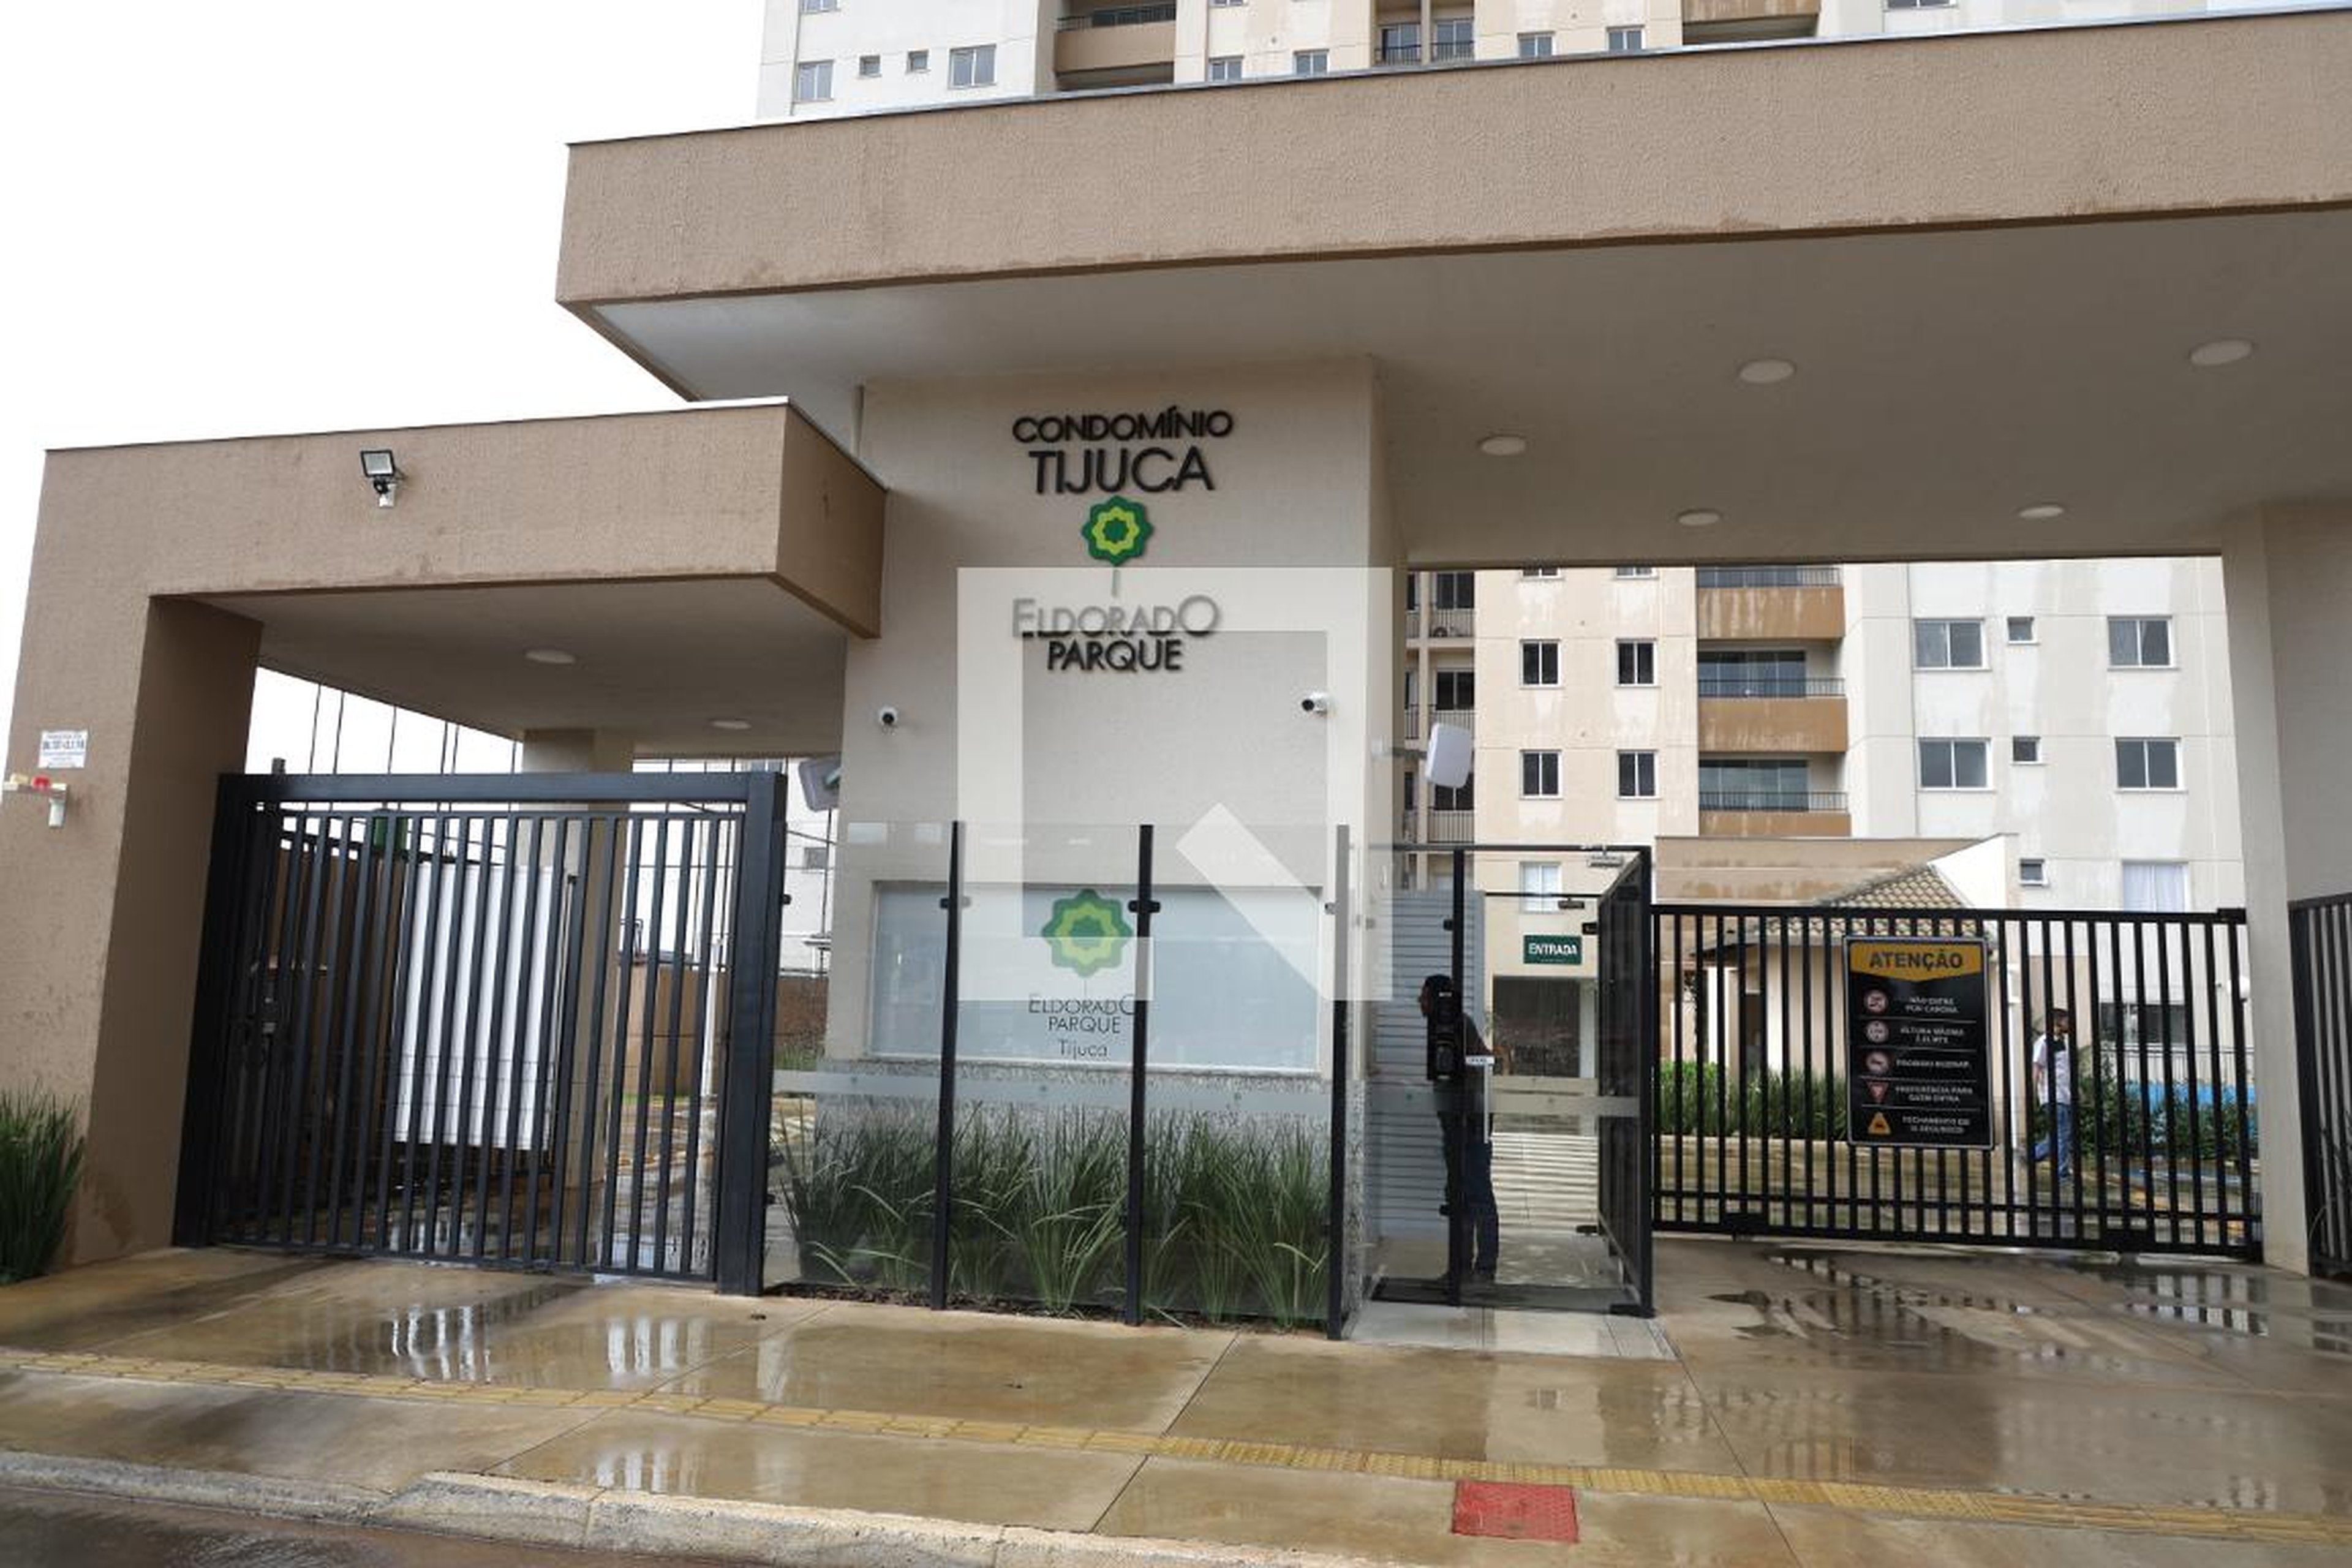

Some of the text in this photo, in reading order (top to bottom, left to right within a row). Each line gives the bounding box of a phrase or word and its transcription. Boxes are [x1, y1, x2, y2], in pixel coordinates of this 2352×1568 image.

[1012, 405, 1234, 443] CONDOMÍNIO
[1028, 446, 1215, 494] TIJUCA
[1012, 594, 1221, 638] ELDORADO
[1047, 638, 1182, 672] PARQUE
[1528, 943, 1577, 956] ENTRADA
[1870, 949, 1964, 971] ATENÇÃO
[1048, 1016, 1121, 1033] PARQUE
[1059, 1040, 1108, 1060] Tijuca
